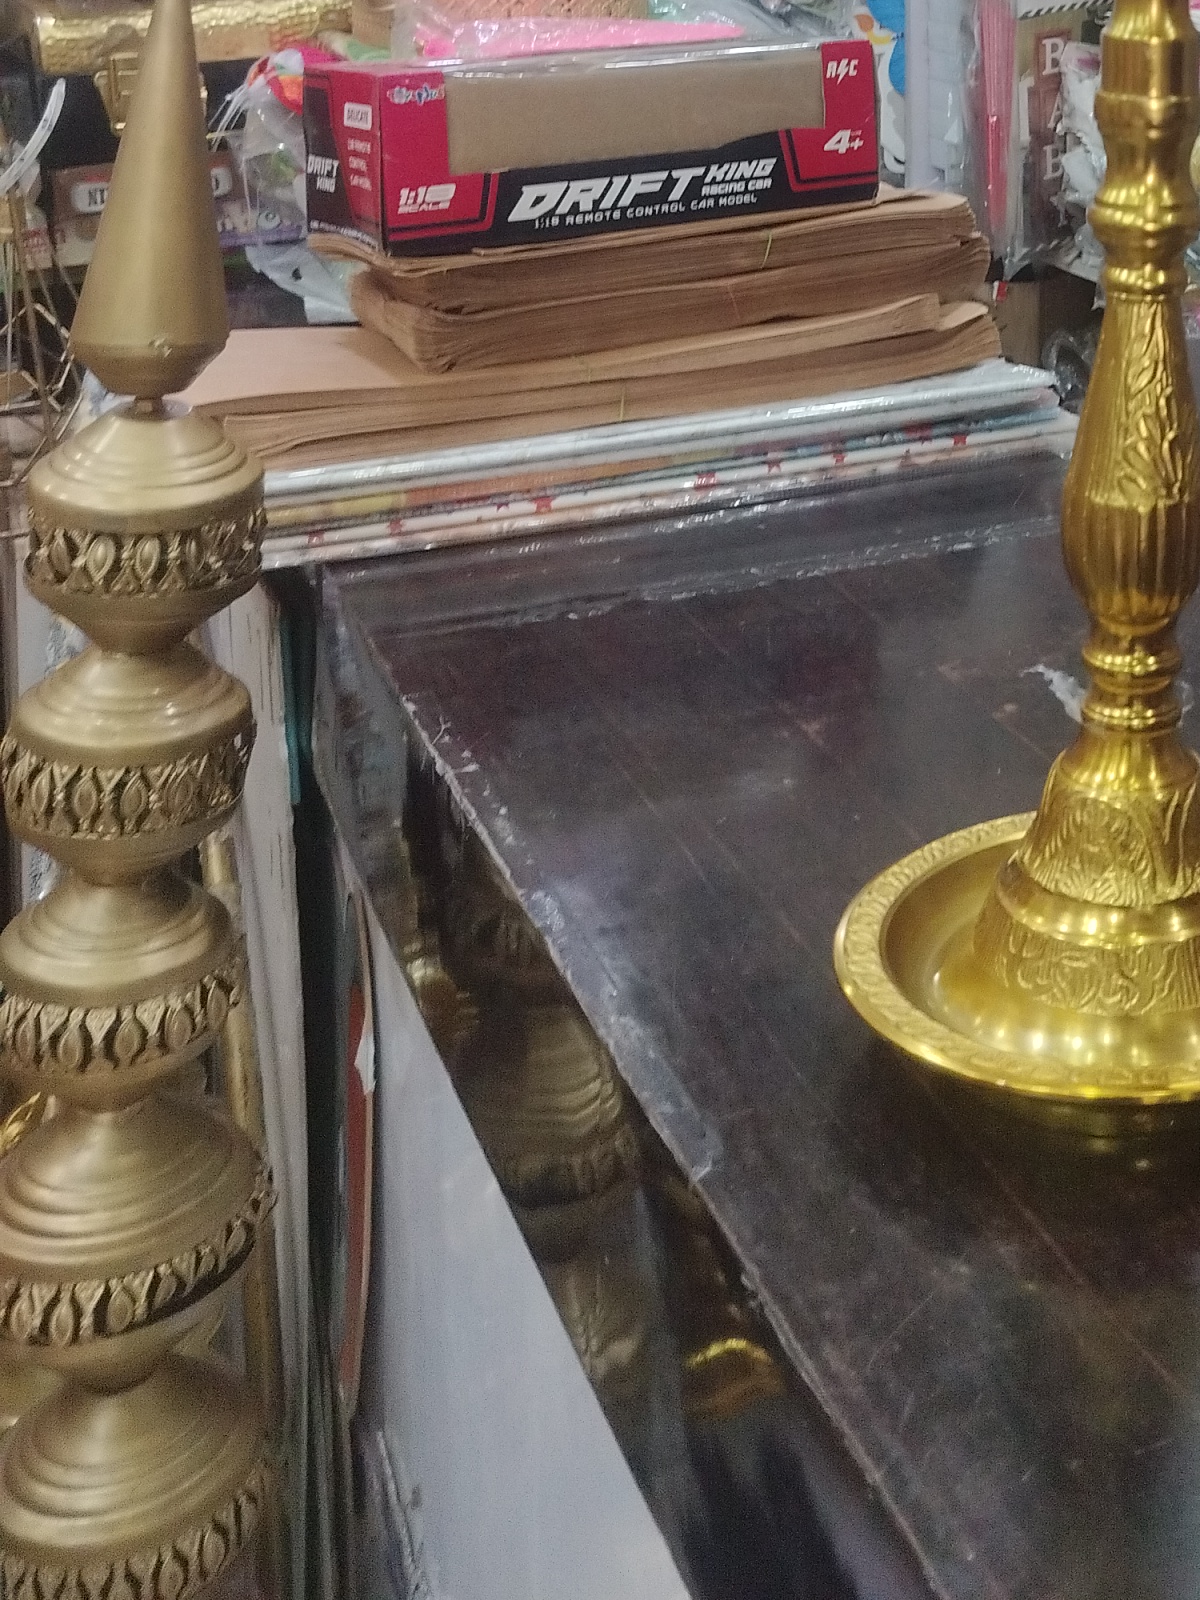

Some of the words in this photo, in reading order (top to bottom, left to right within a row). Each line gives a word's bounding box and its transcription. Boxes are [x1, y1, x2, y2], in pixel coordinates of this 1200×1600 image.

[307, 153, 339, 178] DRIFT
[316, 176, 337, 194] KING
[507, 166, 704, 224] DRIFT
[701, 157, 778, 184] KING
[701, 180, 742, 197] RACING
[744, 177, 772, 191] CAR
[565, 211, 622, 227] REMOTE
[626, 202, 685, 219] CONTROL
[690, 197, 718, 211] CAR
[721, 192, 758, 208] MODEL
